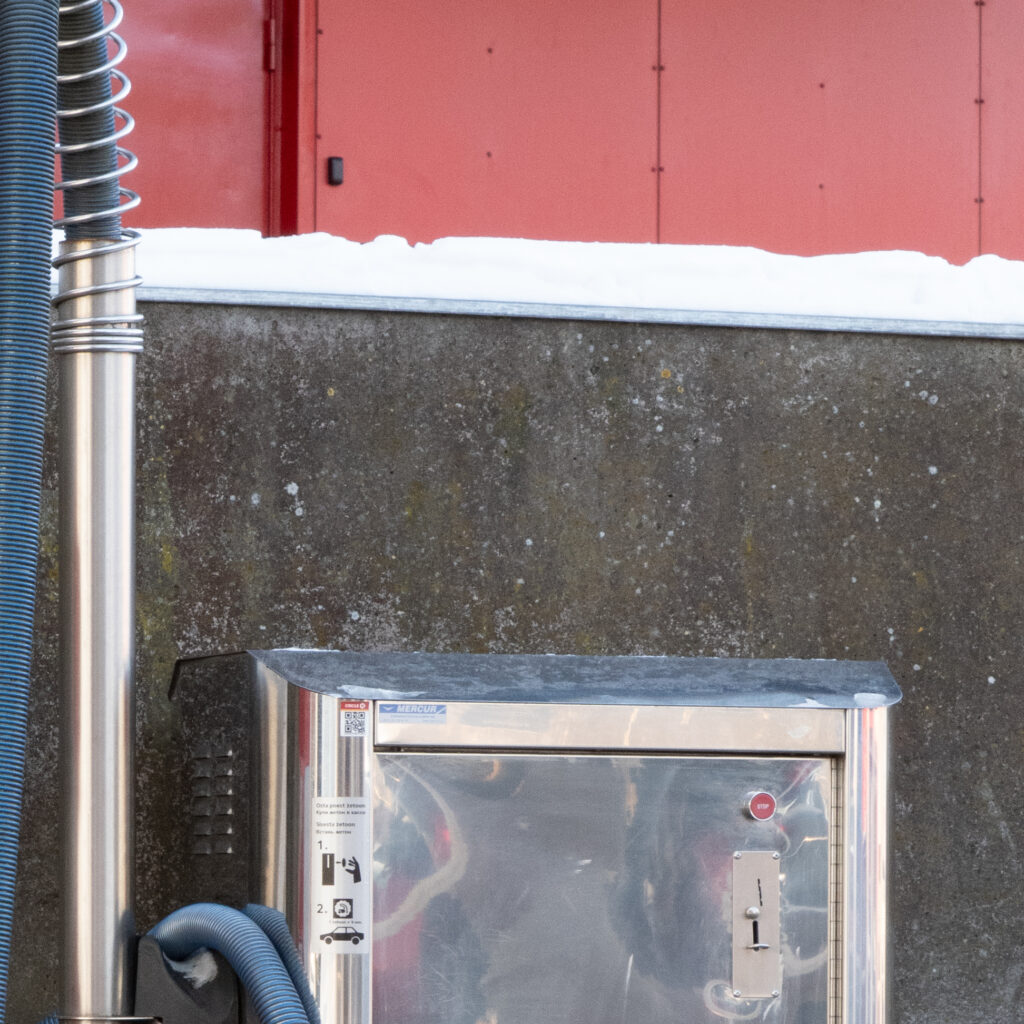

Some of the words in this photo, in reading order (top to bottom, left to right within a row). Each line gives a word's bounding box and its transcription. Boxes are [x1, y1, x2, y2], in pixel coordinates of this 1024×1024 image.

[396, 704, 438, 713] MERCUR
[317, 839, 328, 850] 1.
[316, 903, 328, 914] 2.
